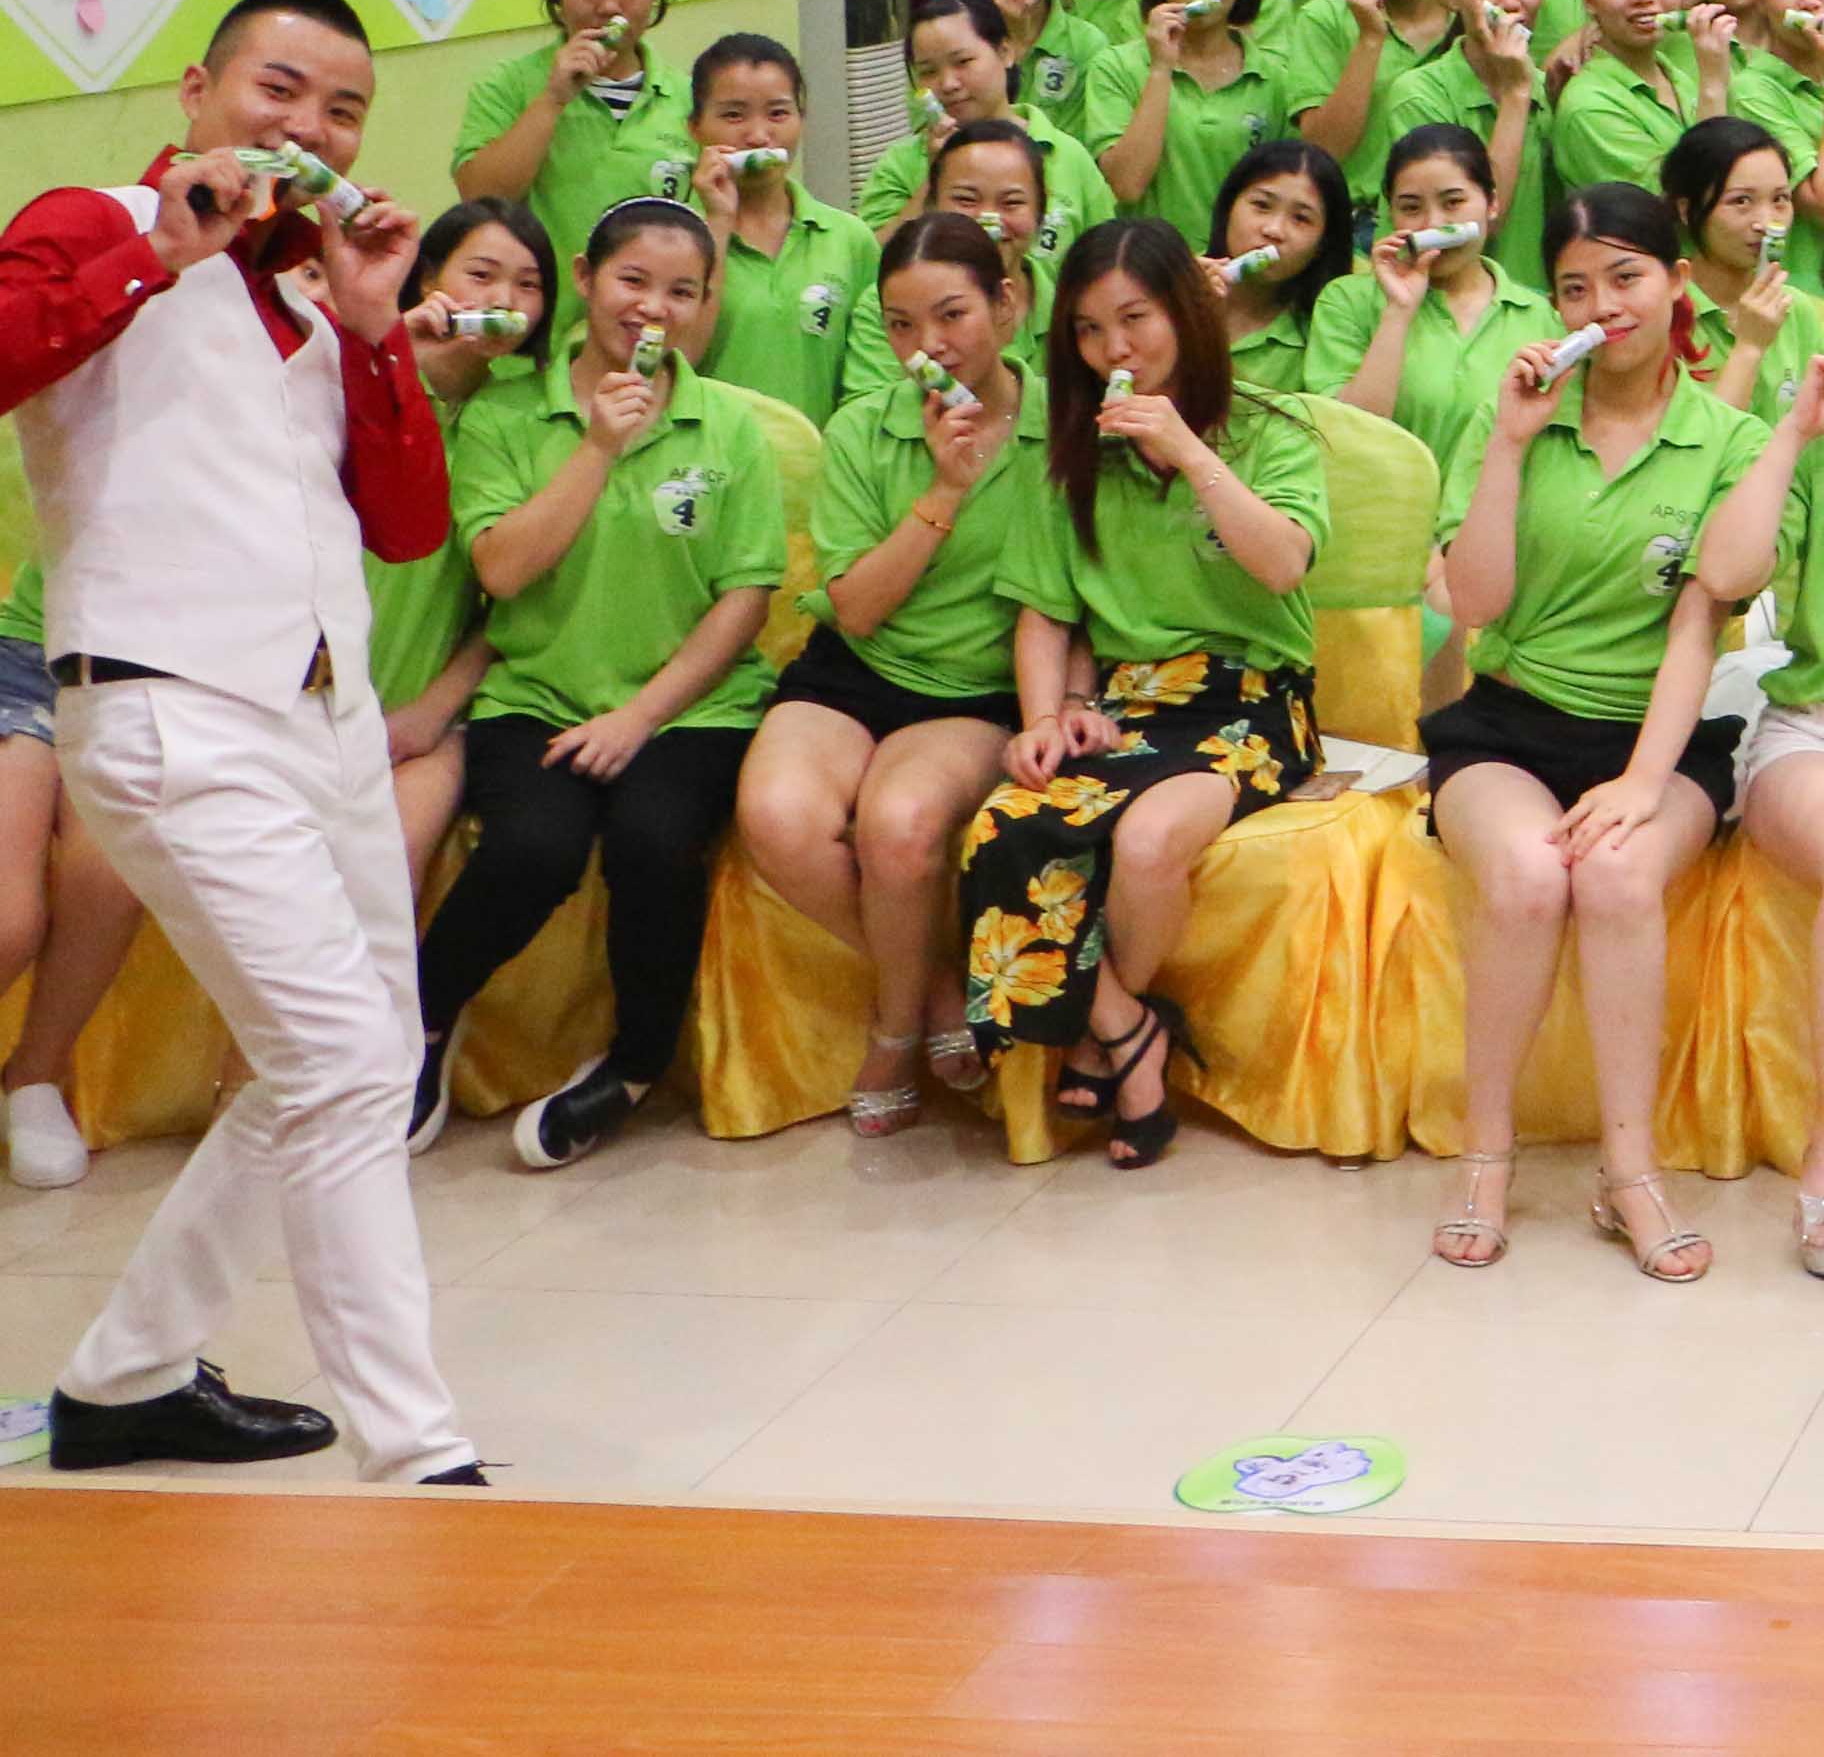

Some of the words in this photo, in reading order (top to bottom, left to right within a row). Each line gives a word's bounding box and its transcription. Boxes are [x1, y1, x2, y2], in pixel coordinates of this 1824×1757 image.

[1044, 69, 1064, 91] 3
[663, 175, 679, 198] 3
[1040, 227, 1058, 252] 3
[812, 305, 832, 331] 4
[670, 498, 697, 528] 4
[1657, 560, 1682, 588] 4
